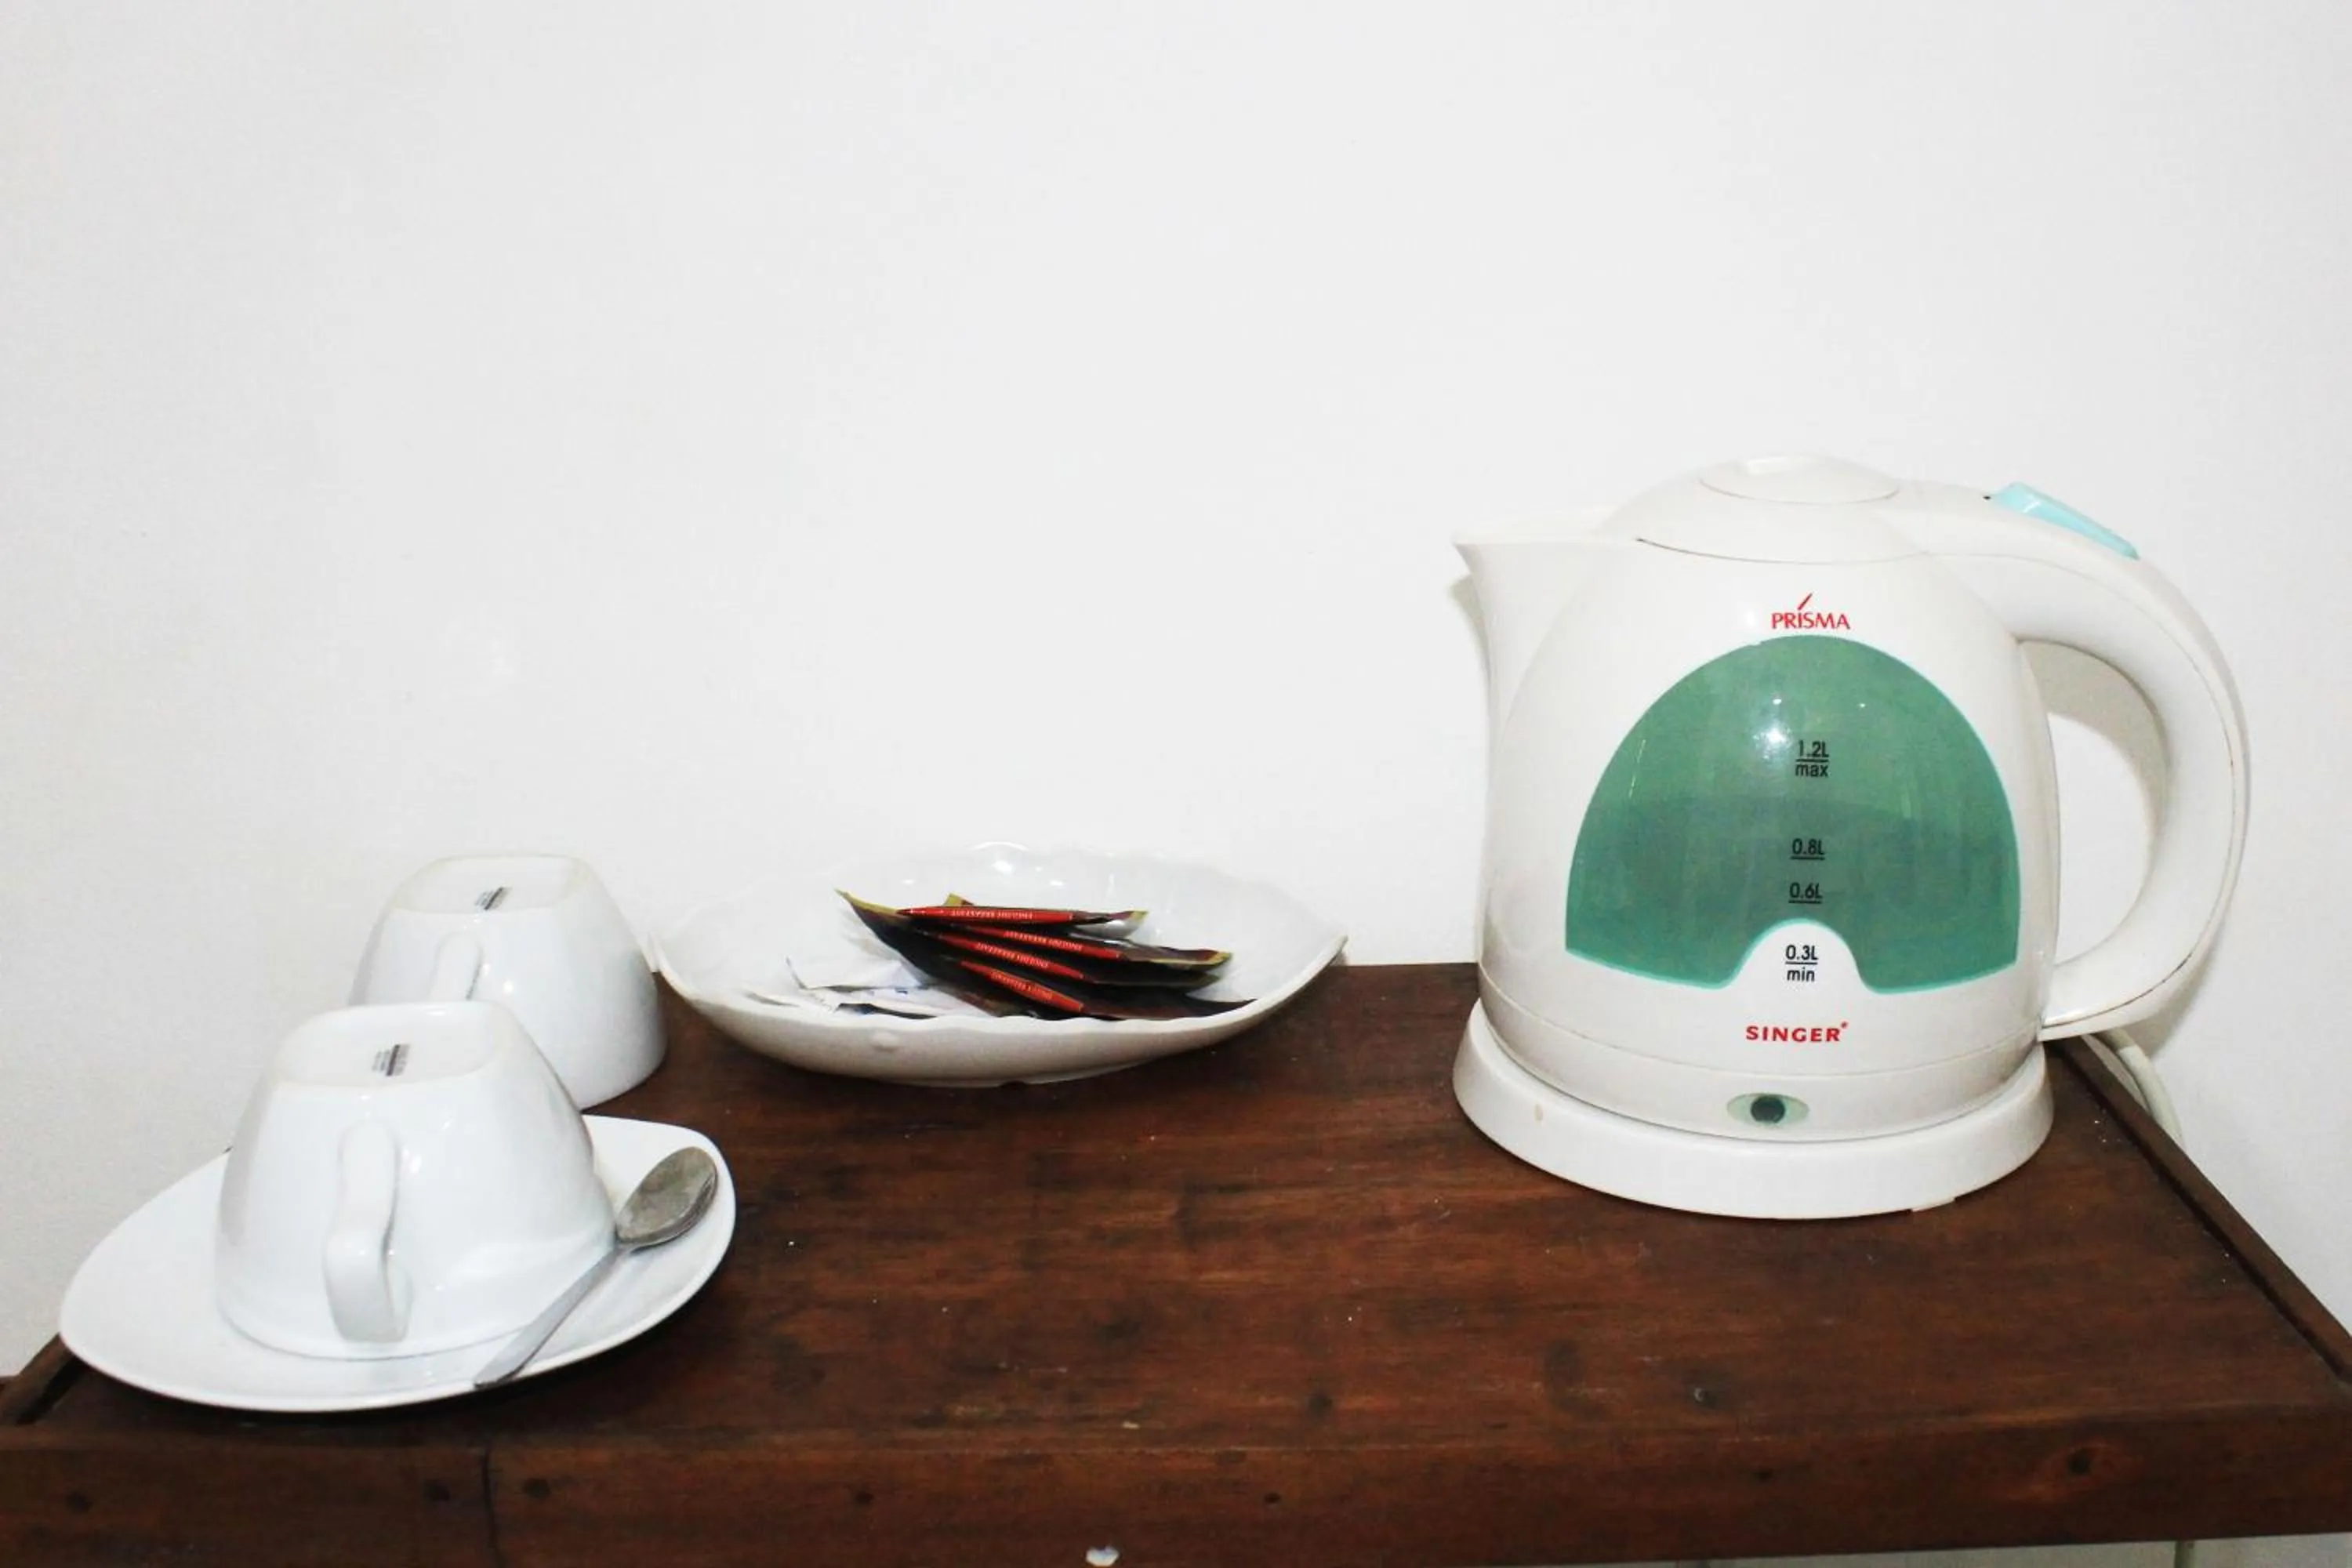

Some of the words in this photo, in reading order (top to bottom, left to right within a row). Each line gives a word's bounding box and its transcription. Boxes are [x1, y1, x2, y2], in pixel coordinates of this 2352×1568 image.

[1798, 741, 1829, 758] 1.2L
[1795, 763, 1828, 777] max
[1791, 838, 1825, 855] 0.8L
[1789, 883, 1823, 899] 0.6L
[1785, 945, 1818, 960] 0.3L
[1787, 967, 1815, 982] min
[1746, 1025, 1841, 1043] SINGER
